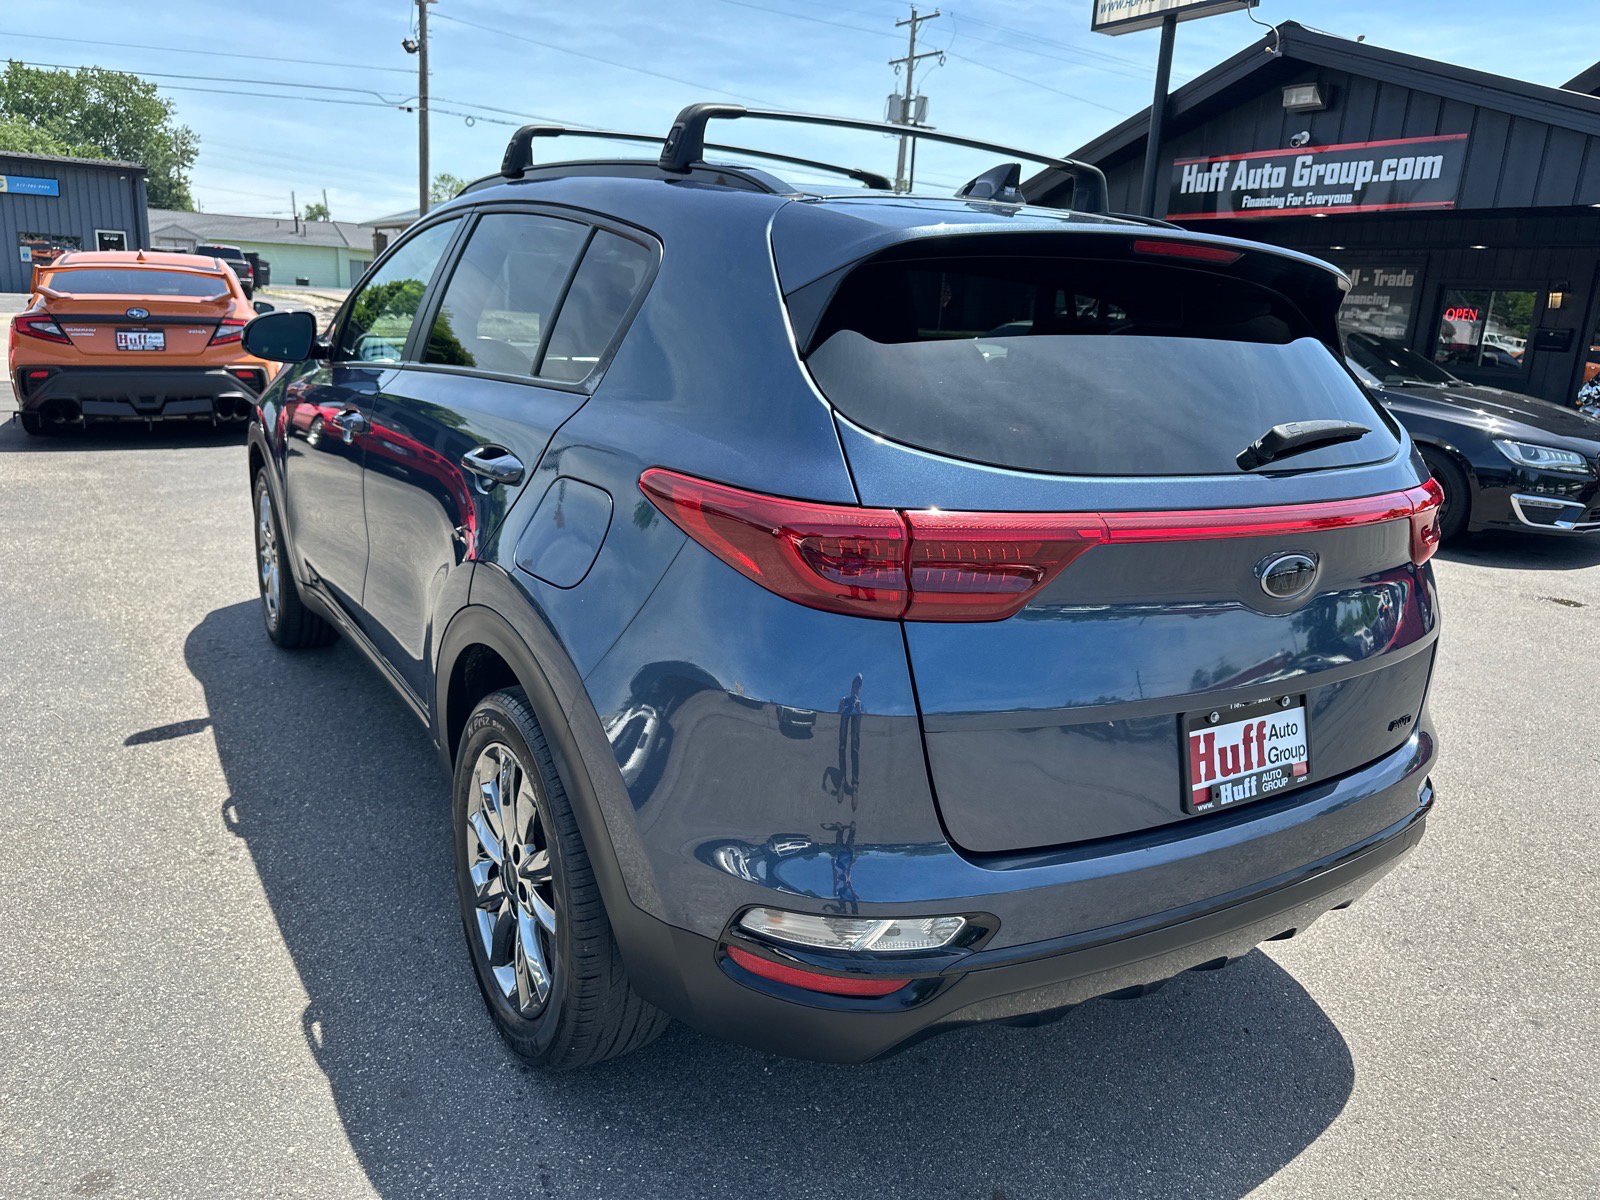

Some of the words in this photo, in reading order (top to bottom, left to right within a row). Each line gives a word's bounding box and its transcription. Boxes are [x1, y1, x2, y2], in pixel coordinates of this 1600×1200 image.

[1180, 161, 1229, 194] Huff
[1231, 160, 1287, 191] Auto
[1292, 154, 1444, 191] Group.com
[1242, 194, 1285, 209] Financing
[1286, 193, 1304, 207] For
[1305, 192, 1352, 206] Everyone
[1373, 269, 1414, 287] Trade
[1343, 292, 1390, 308] inancing
[1444, 308, 1479, 322] OPEN
[118, 334, 147, 345] Huff
[1268, 722, 1298, 741] Auto
[1190, 720, 1267, 784] Huff
[1268, 744, 1306, 764] Group
[1262, 769, 1282, 782] AUTO
[1220, 775, 1257, 805] Huff
[1262, 777, 1288, 792] GROUP
